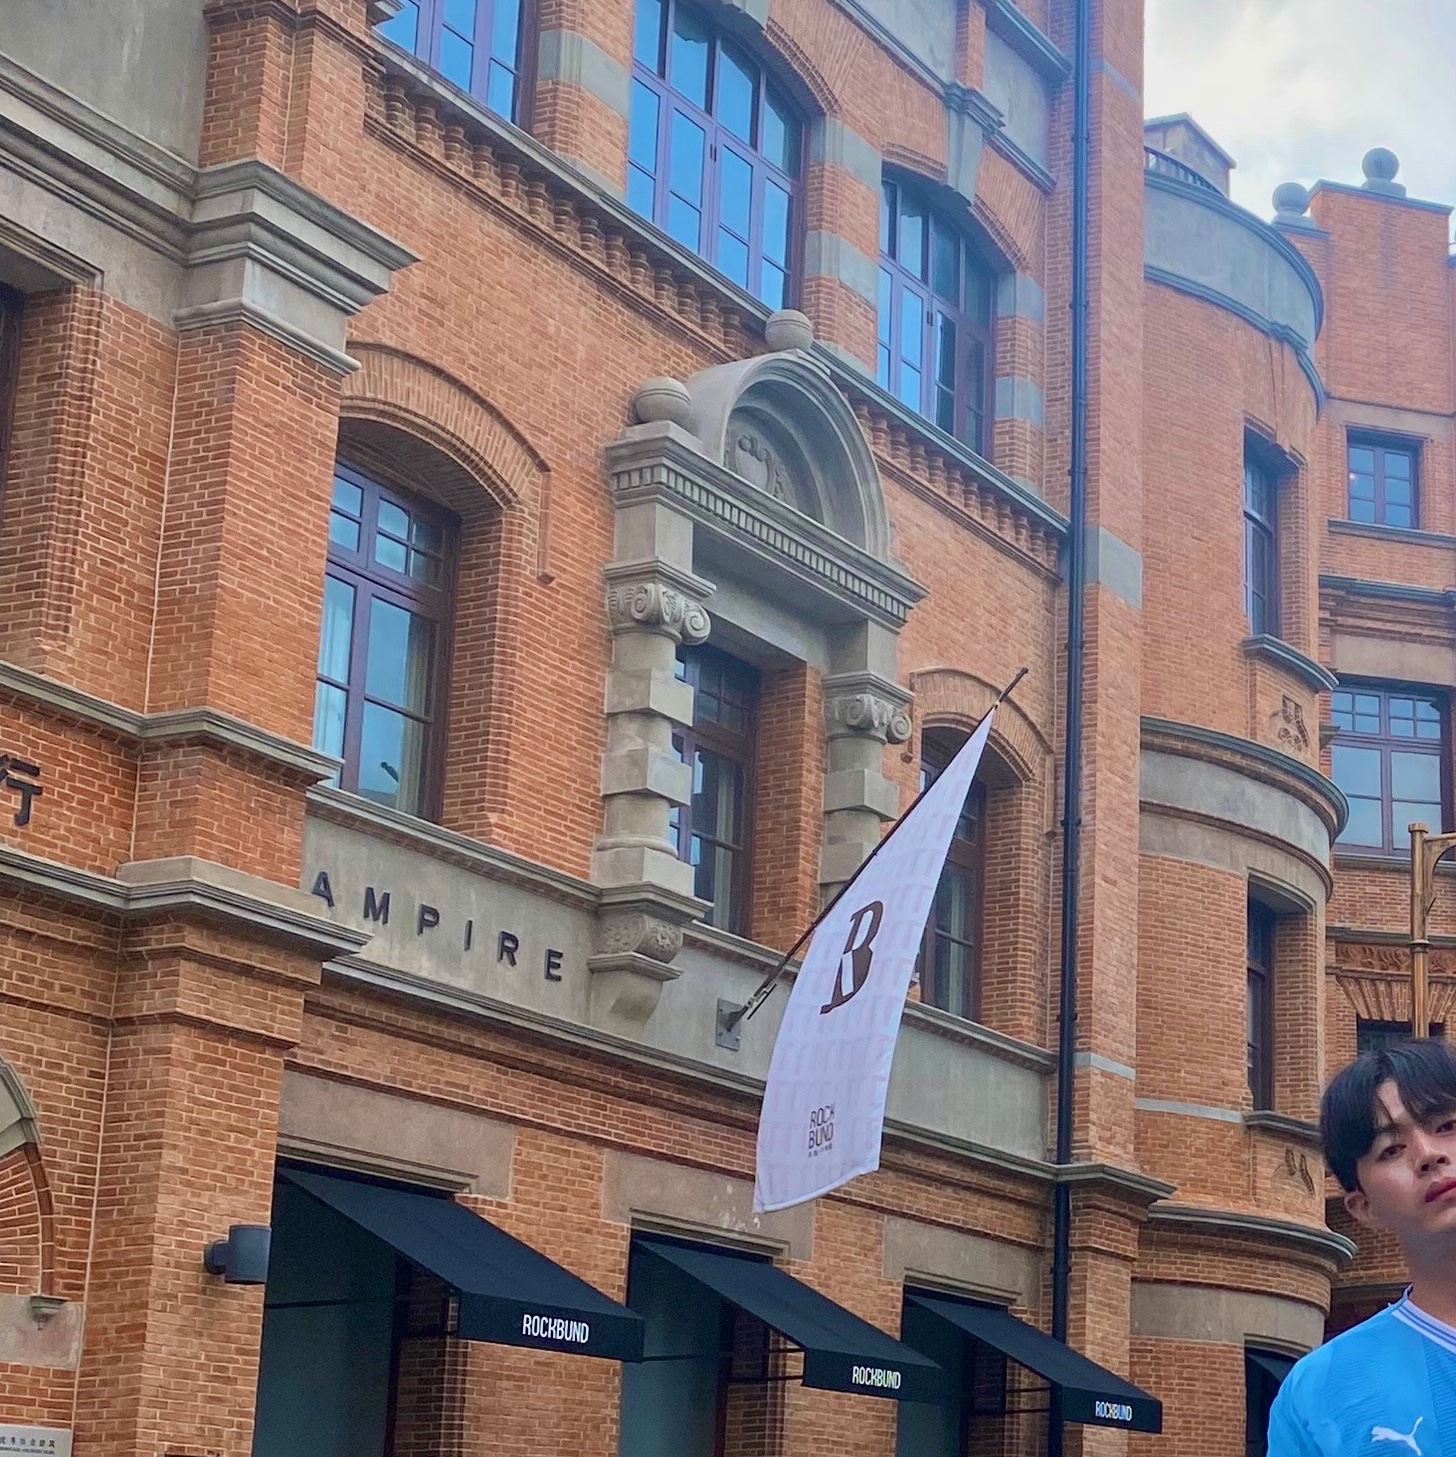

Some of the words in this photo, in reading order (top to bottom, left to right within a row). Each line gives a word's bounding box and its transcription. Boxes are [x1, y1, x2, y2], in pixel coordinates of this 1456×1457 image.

[311, 871, 564, 982] AMPIRE
[810, 1103, 835, 1129] ROCK
[808, 1122, 834, 1149] BUND
[522, 1313, 590, 1344] ROCKBUND
[851, 1365, 902, 1390] ROCKBUND
[1095, 1400, 1133, 1421] ROCKBUND
